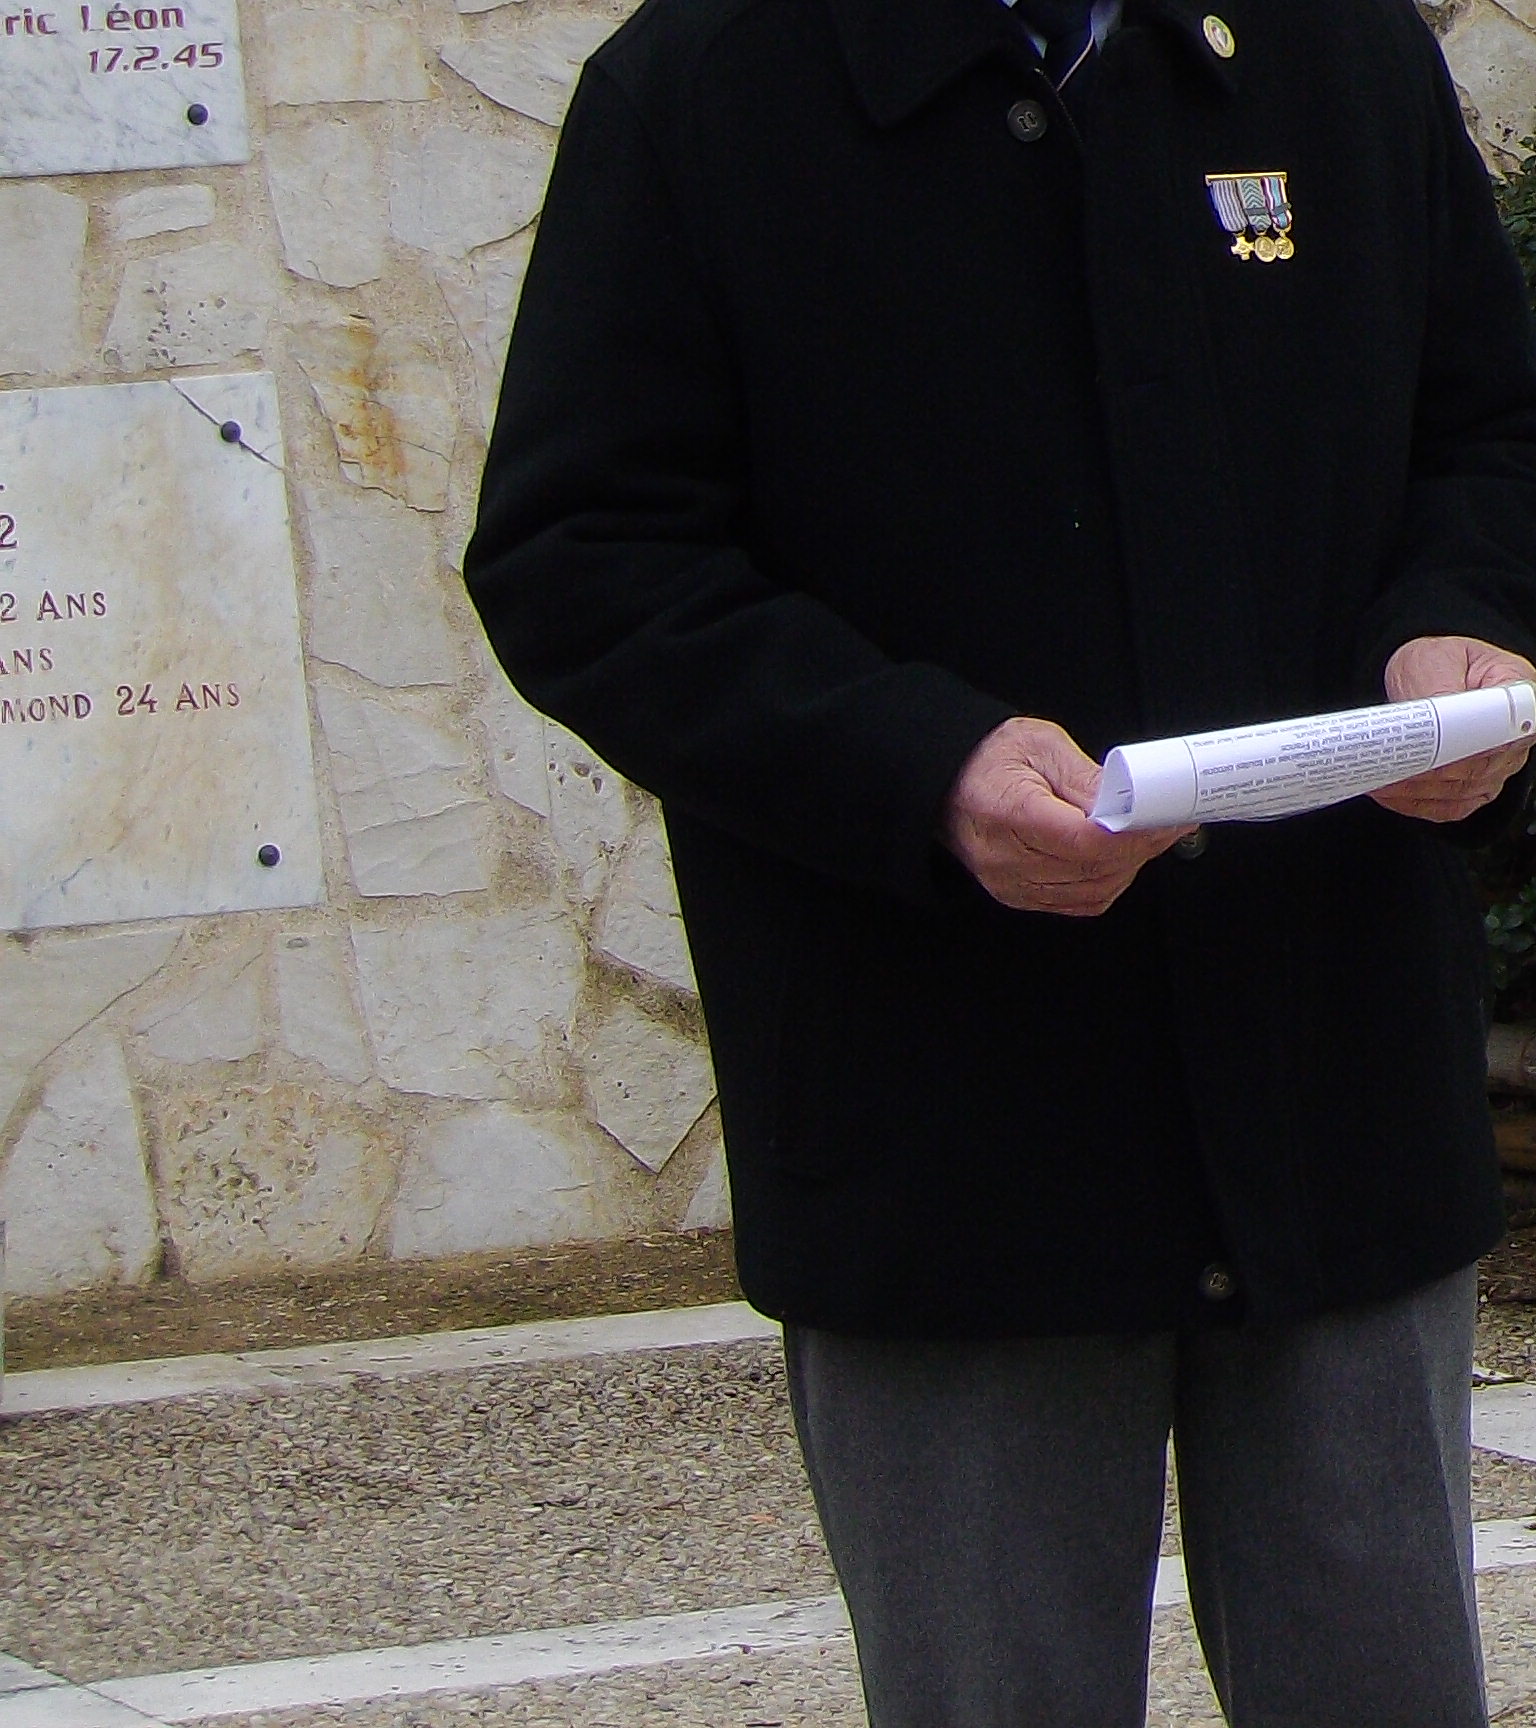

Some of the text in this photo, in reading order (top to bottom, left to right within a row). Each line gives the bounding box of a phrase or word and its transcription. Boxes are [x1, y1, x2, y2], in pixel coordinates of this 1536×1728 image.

[5, 2, 185, 36] ric Léon
[88, 42, 225, 73] 17.2.45
[37, 590, 107, 622] ANS
[116, 683, 159, 716] 24
[176, 681, 242, 712] ANS
